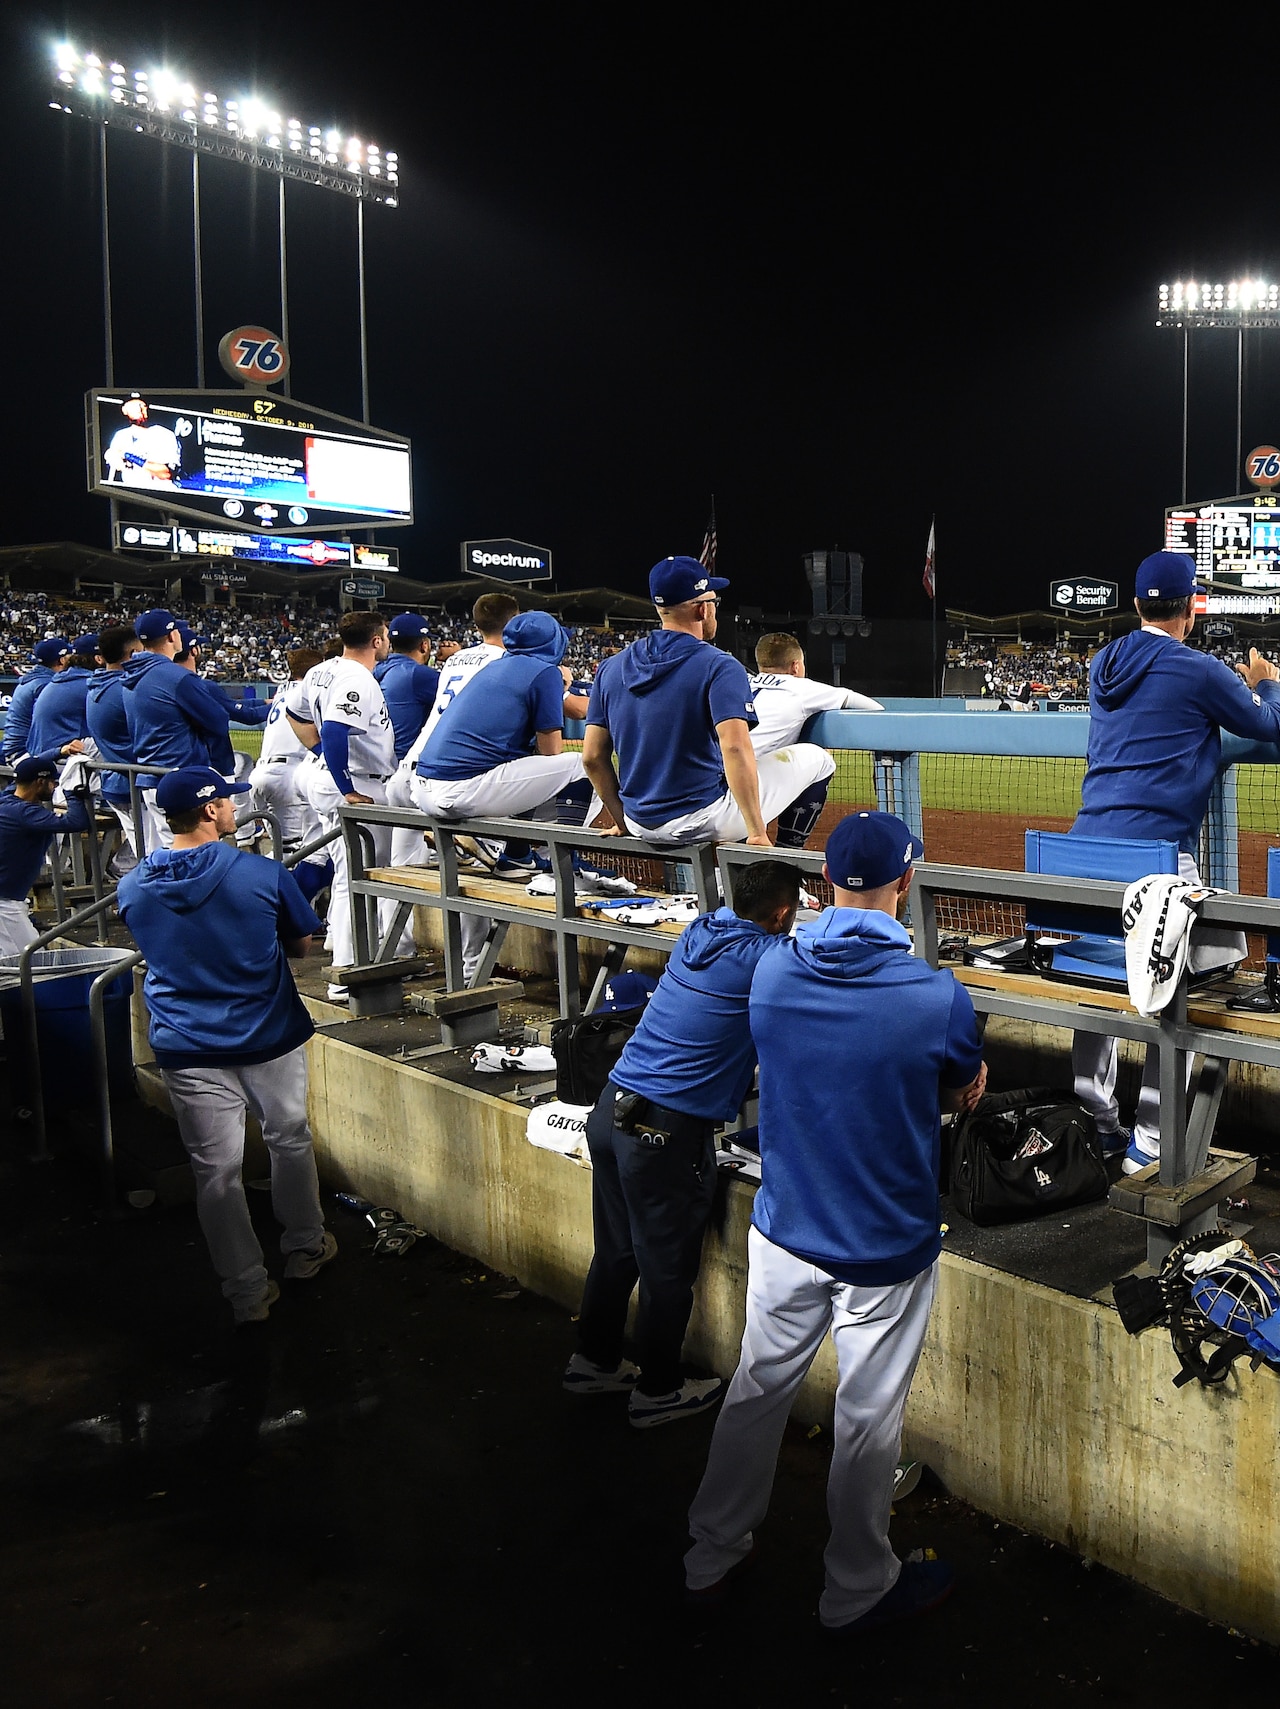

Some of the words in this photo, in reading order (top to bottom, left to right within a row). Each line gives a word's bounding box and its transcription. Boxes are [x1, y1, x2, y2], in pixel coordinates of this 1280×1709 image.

[235, 338, 283, 373] 76
[256, 415, 285, 425] OCTOBER
[298, 421, 314, 430] 2019
[1254, 497, 1277, 507] 9:42
[471, 549, 541, 568] Spectrum
[1076, 585, 1112, 597] Security
[1076, 595, 1107, 605] Benefit
[437, 674, 464, 715] 5
